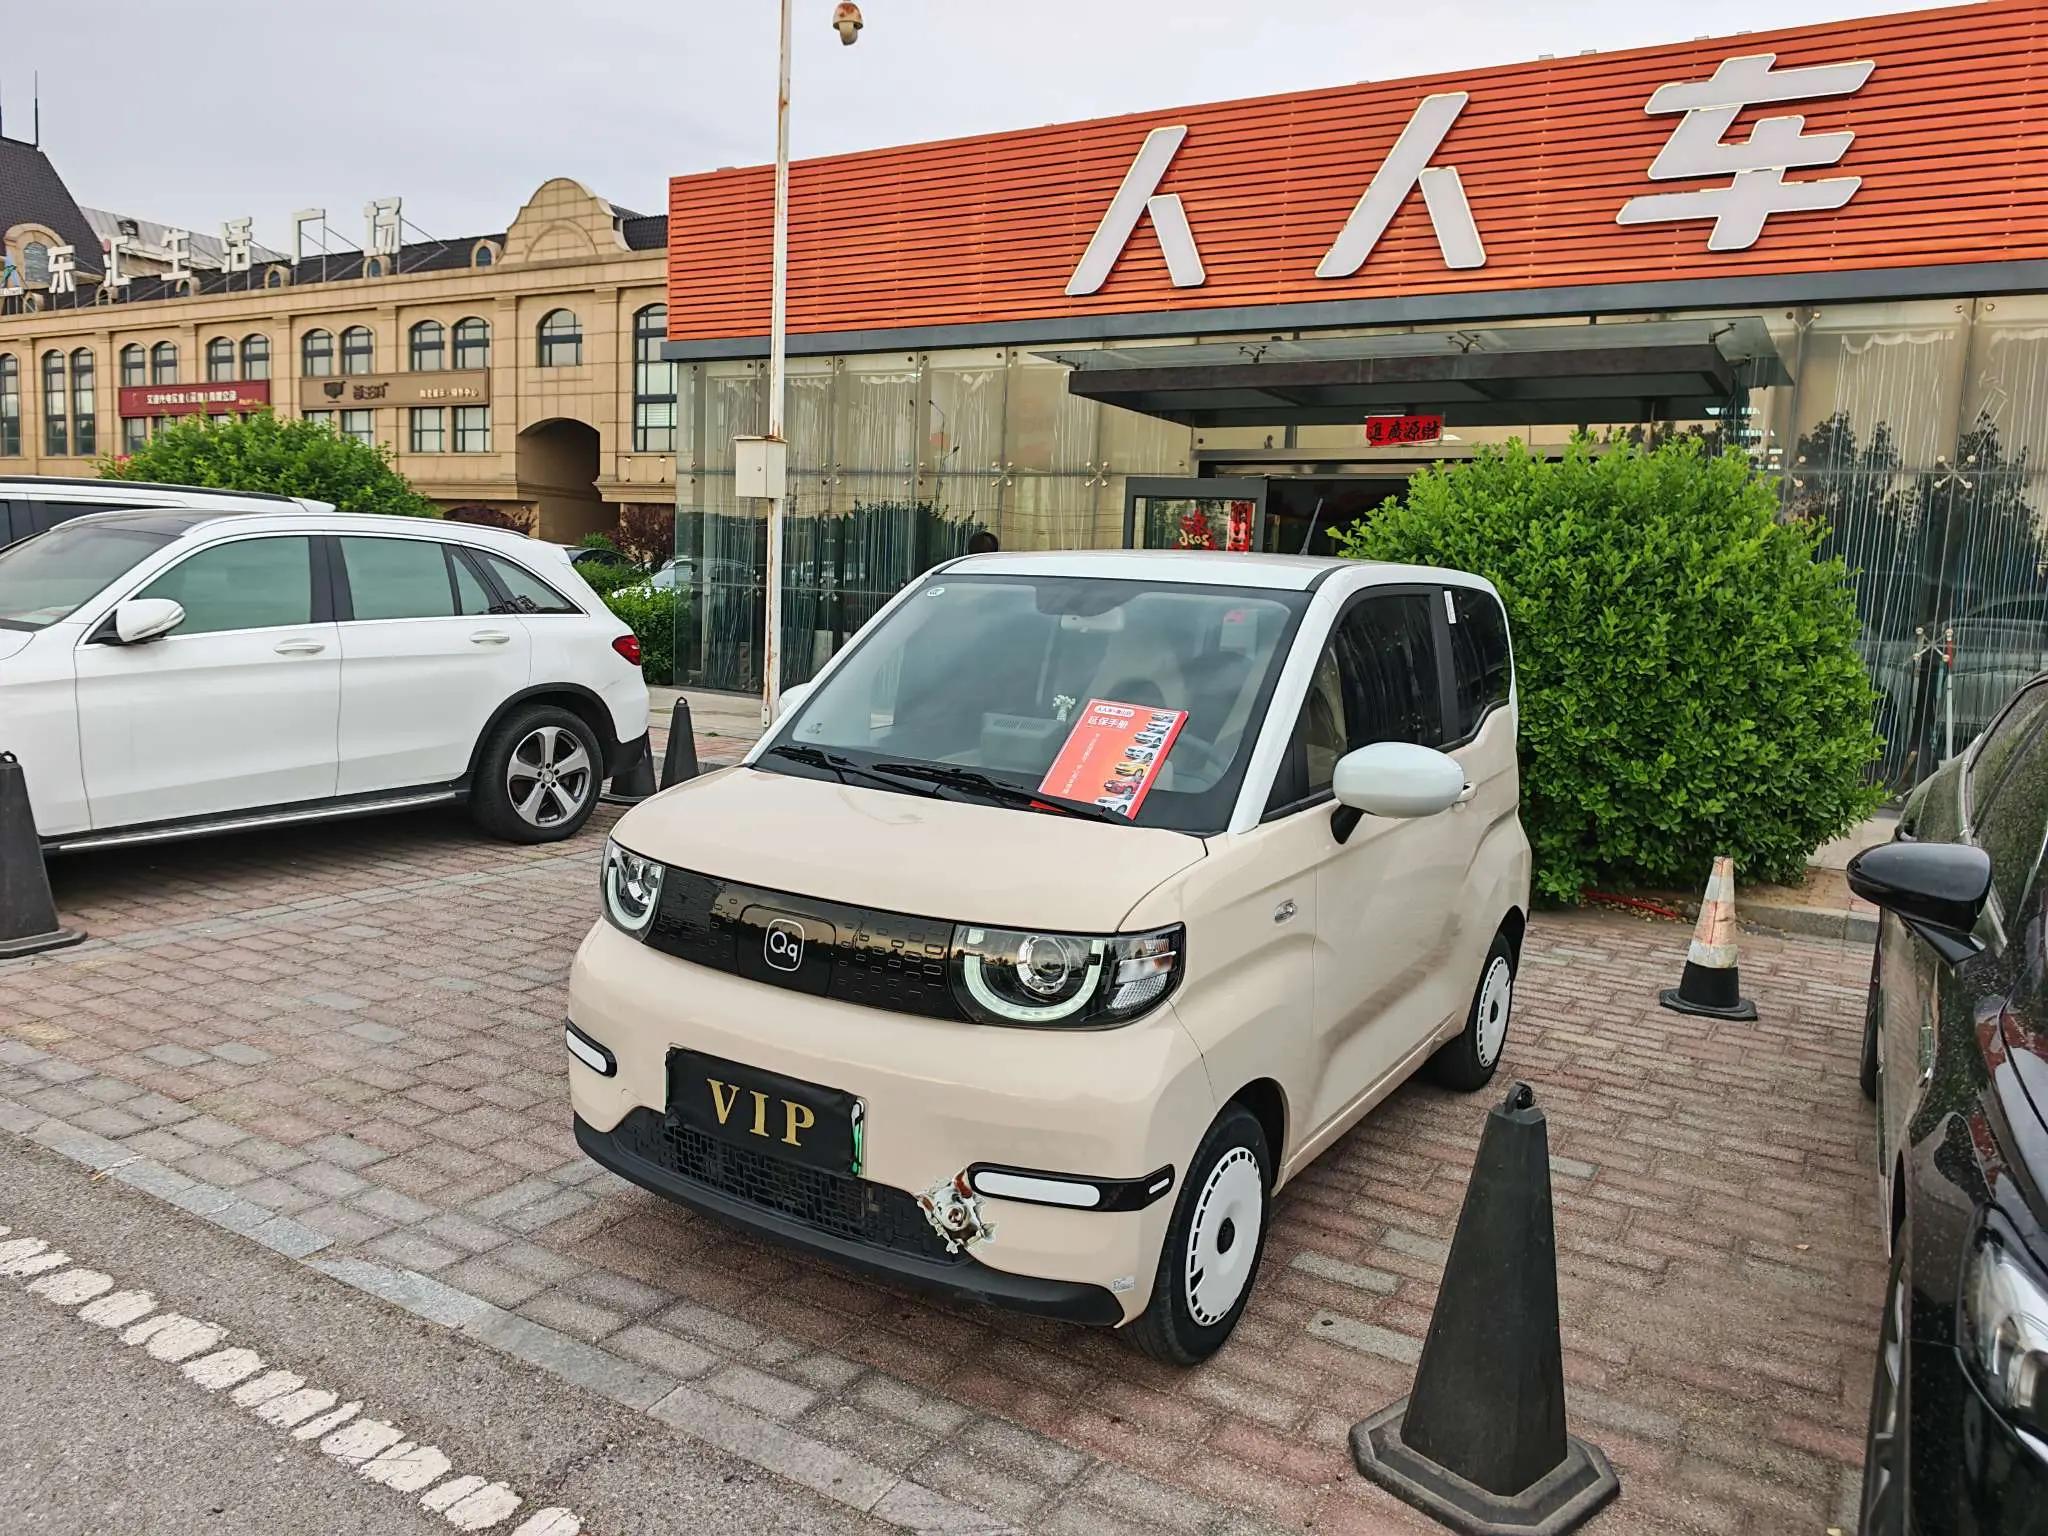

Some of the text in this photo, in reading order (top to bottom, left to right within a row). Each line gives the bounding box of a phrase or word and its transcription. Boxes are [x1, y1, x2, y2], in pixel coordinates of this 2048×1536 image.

[1064, 52, 1876, 296] 人人车
[706, 1077, 815, 1147] VIP
